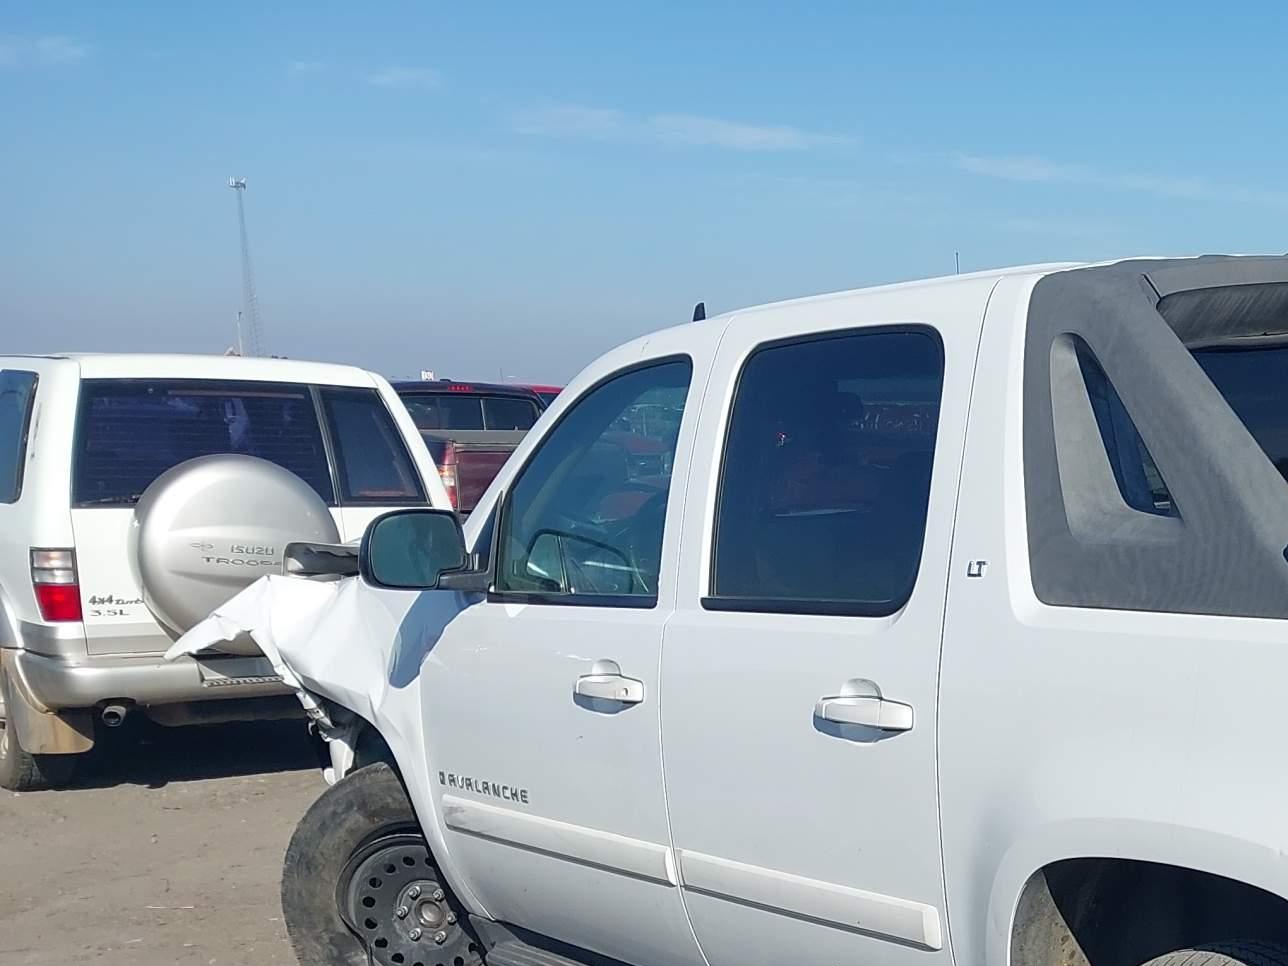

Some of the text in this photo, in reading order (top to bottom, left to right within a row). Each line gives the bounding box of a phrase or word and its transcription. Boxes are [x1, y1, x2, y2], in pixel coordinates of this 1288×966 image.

[231, 544, 274, 556] ISUZU
[967, 560, 987, 577] LT
[447, 773, 529, 804] AVALANCHE
